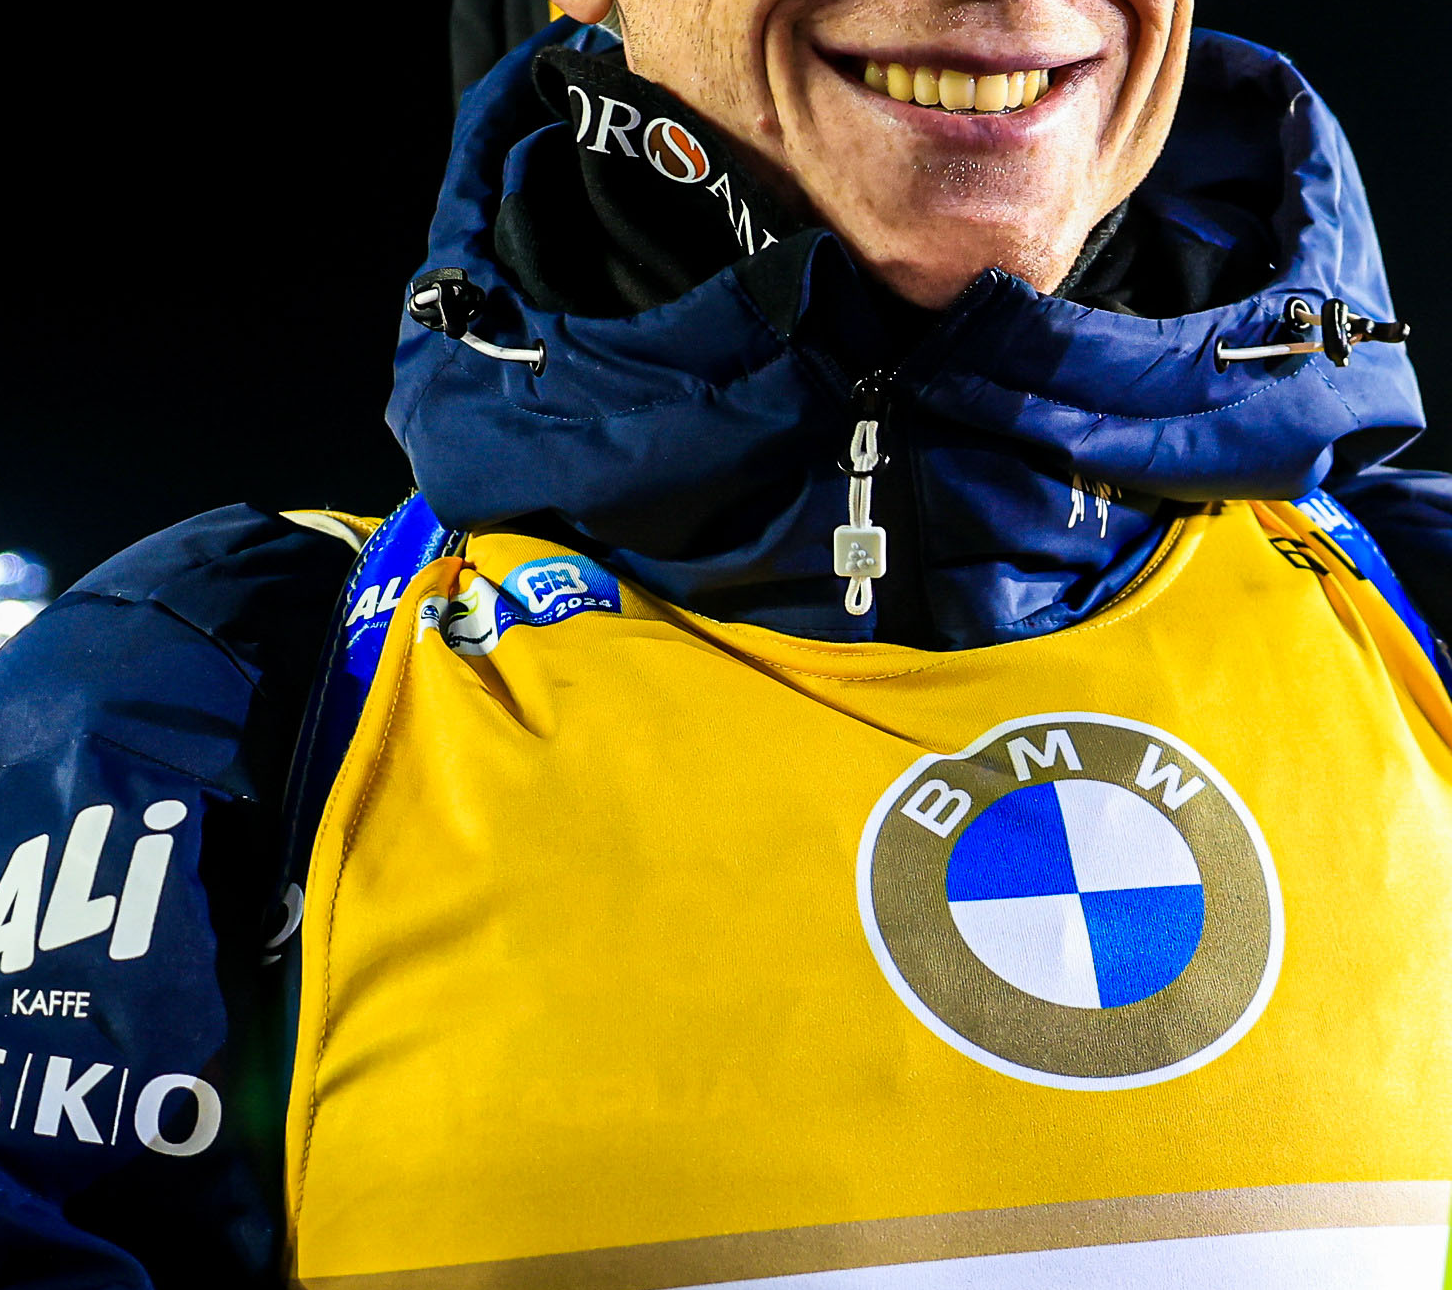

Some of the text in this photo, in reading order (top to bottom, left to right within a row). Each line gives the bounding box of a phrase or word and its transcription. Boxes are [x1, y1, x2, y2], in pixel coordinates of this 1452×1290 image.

[555, 597, 613, 618] 2024
[900, 728, 1206, 840] BMW
[11, 988, 91, 1019] KAFFE
